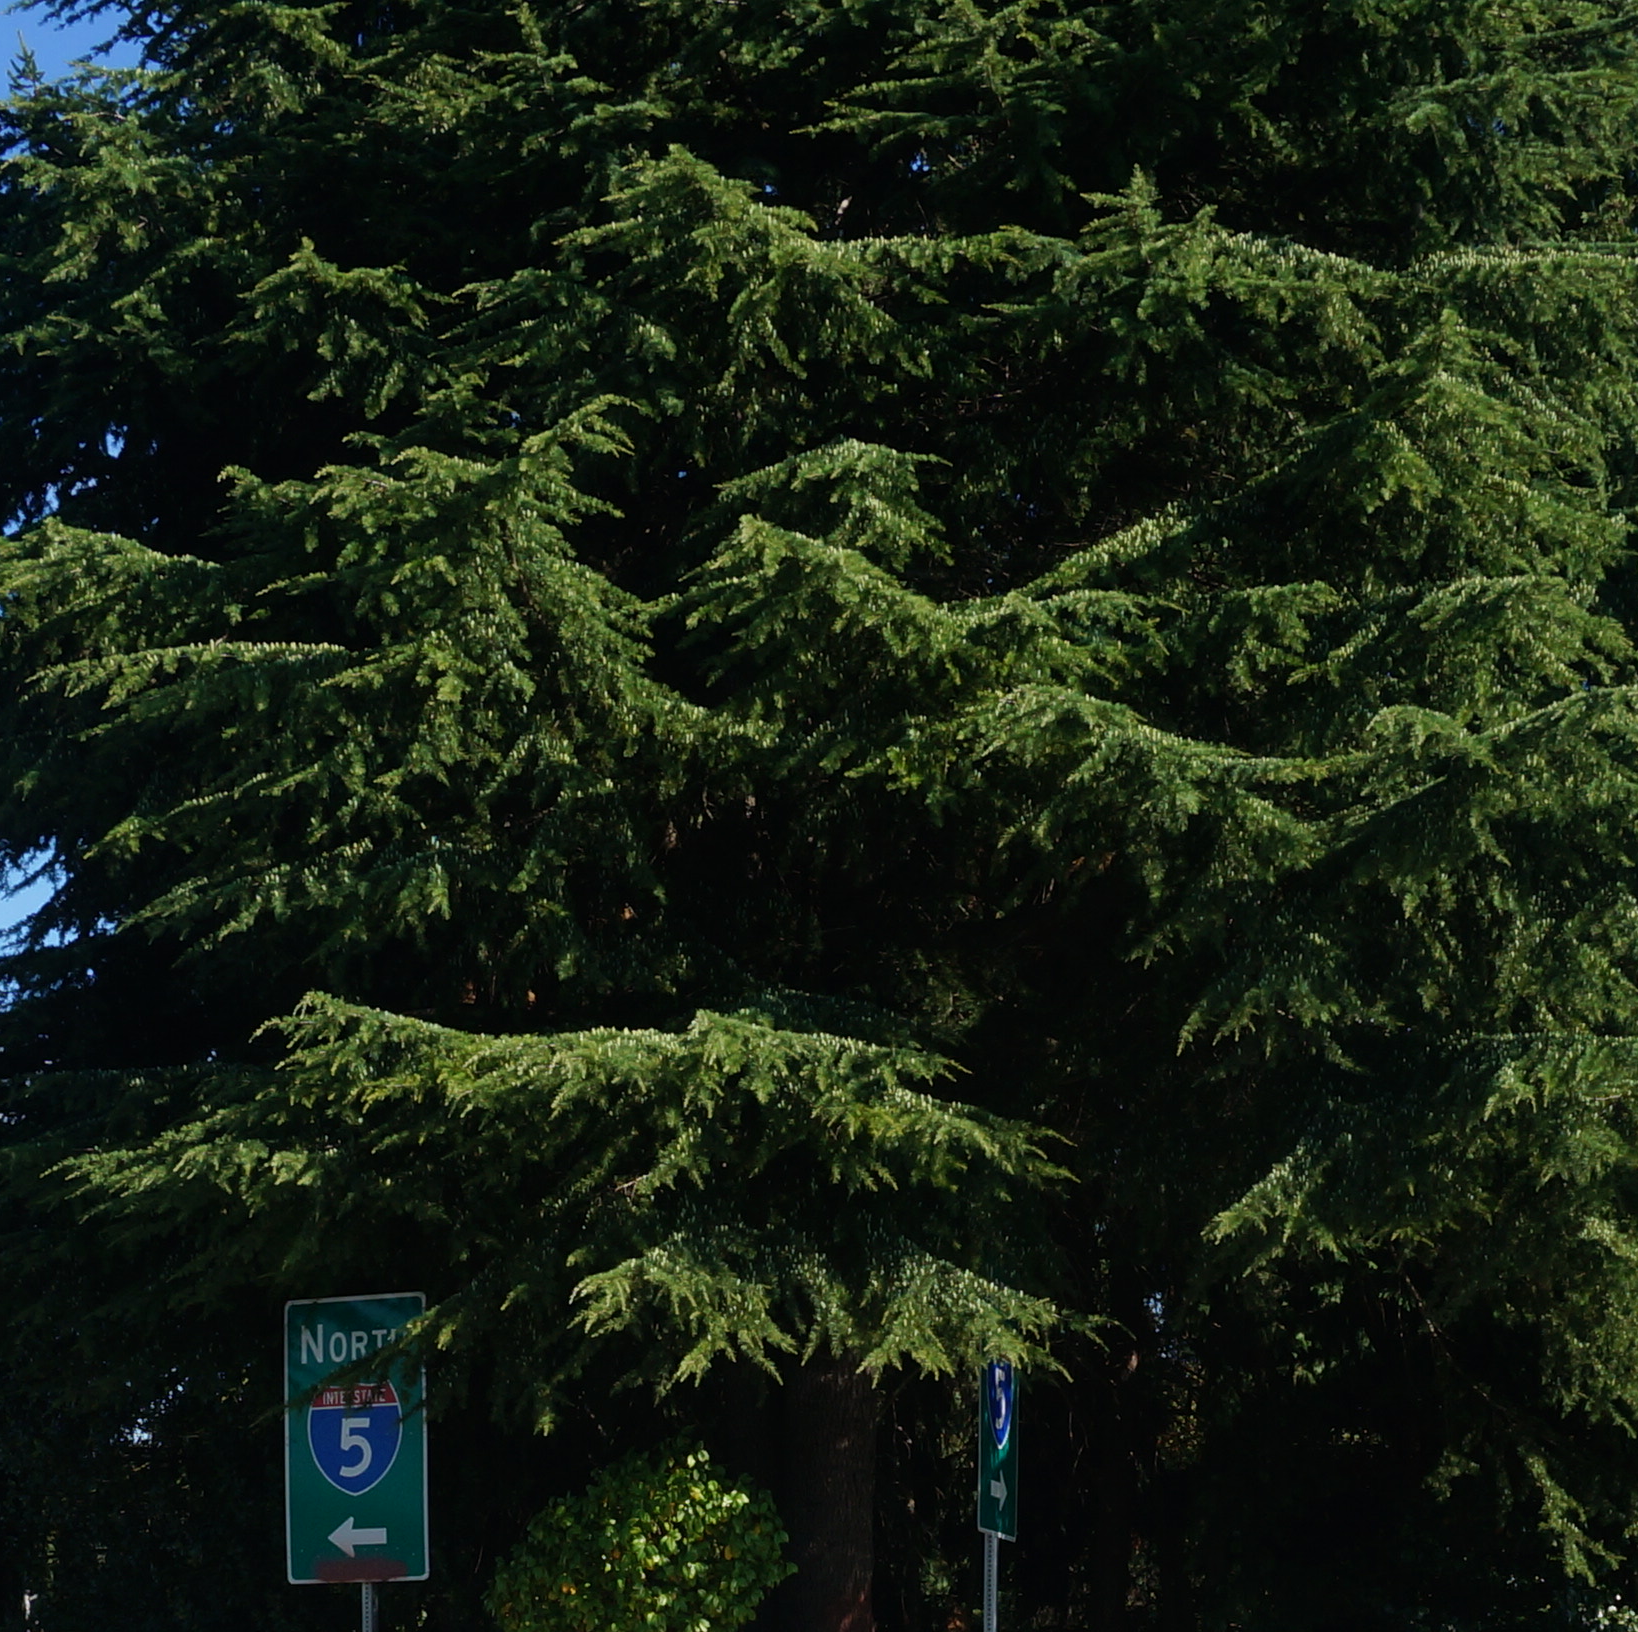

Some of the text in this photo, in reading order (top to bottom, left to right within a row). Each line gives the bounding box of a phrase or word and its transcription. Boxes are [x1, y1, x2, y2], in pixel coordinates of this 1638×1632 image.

[322, 1388, 387, 1405] INTESTATE
[995, 1367, 1006, 1430] 5
[339, 1417, 373, 1478] 5
